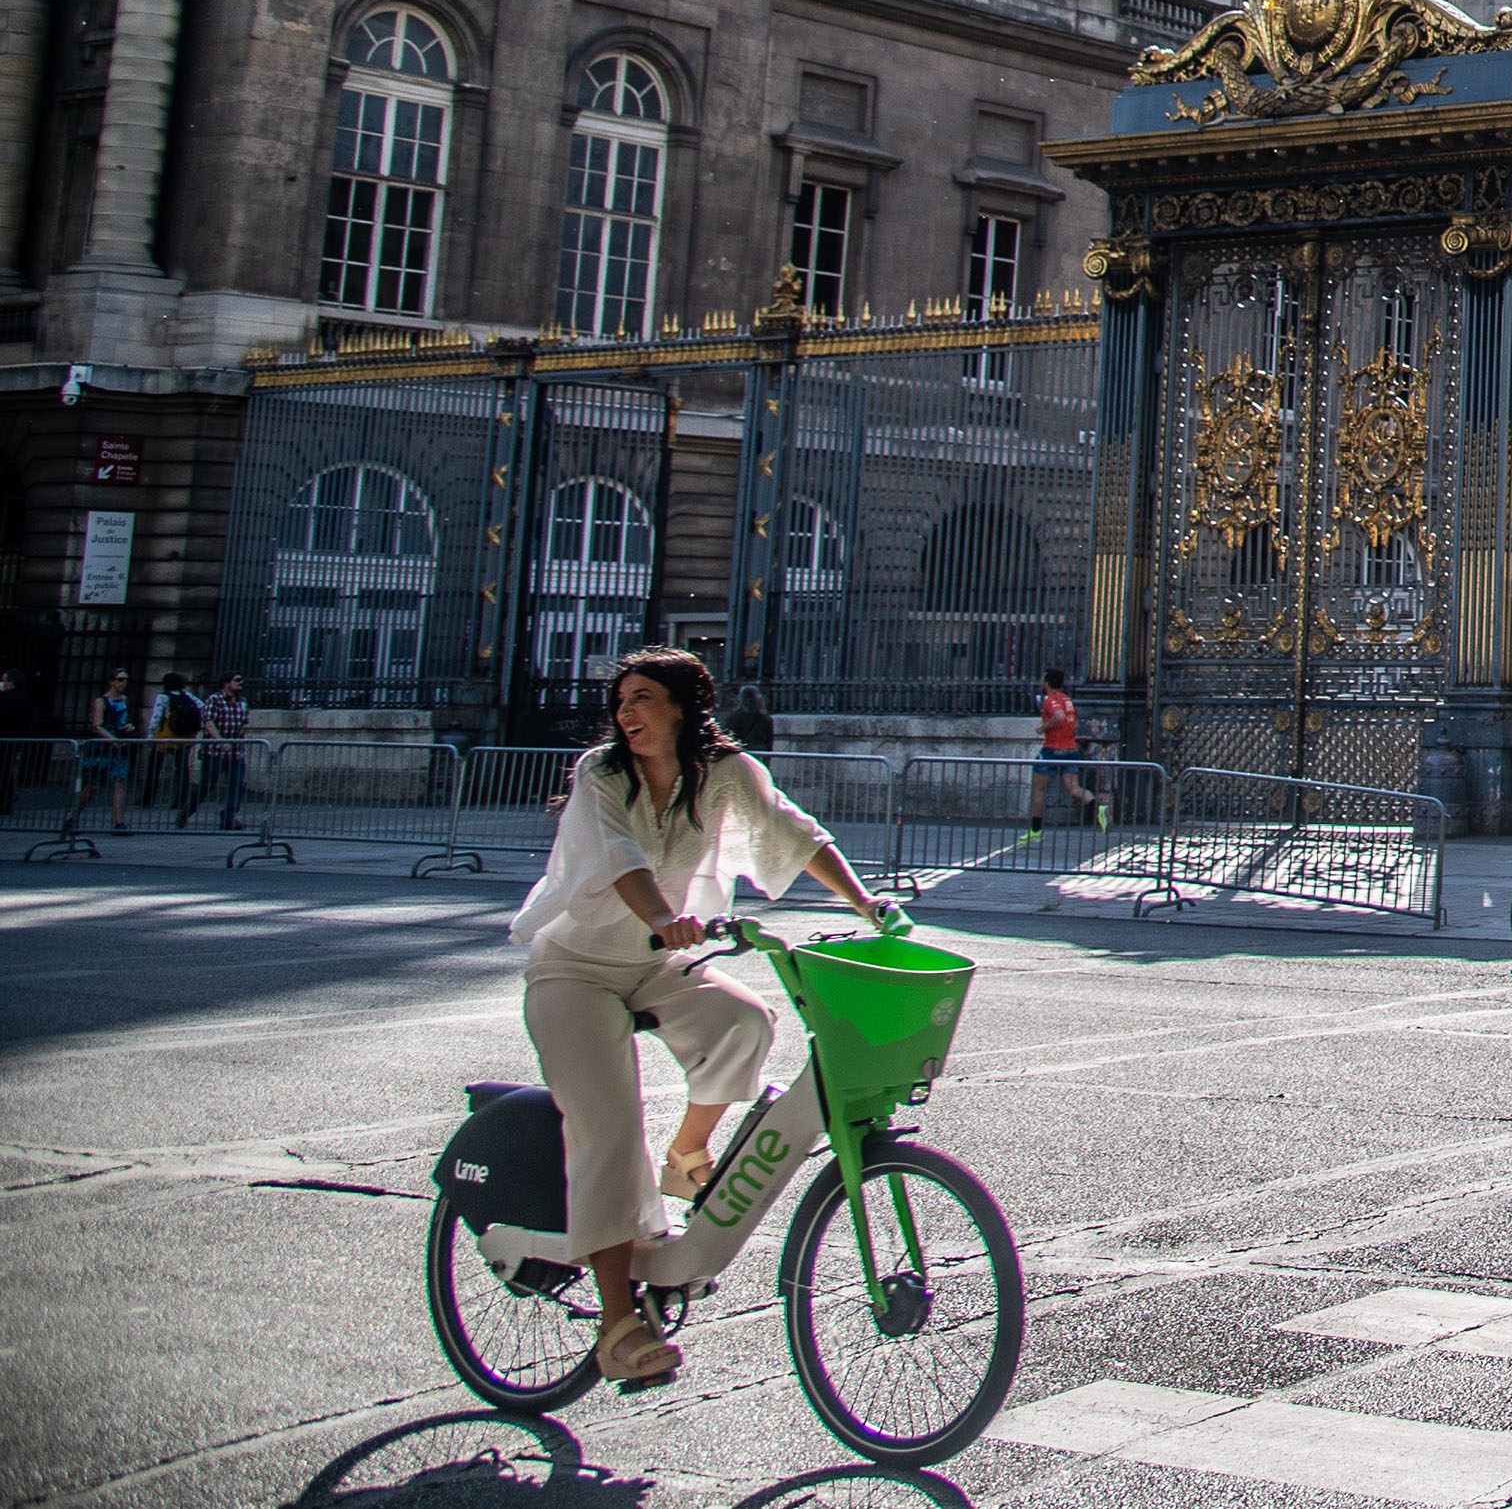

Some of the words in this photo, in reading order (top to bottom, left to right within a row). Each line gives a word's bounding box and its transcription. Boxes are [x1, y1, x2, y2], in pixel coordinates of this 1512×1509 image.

[102, 440, 130, 450] Sainte
[101, 450, 139, 461] Chapelle
[96, 516, 127, 527] Palais
[91, 534, 129, 544] Justice
[94, 582, 119, 590] public
[455, 1158, 490, 1184] Lime
[701, 1128, 791, 1227] Lime
